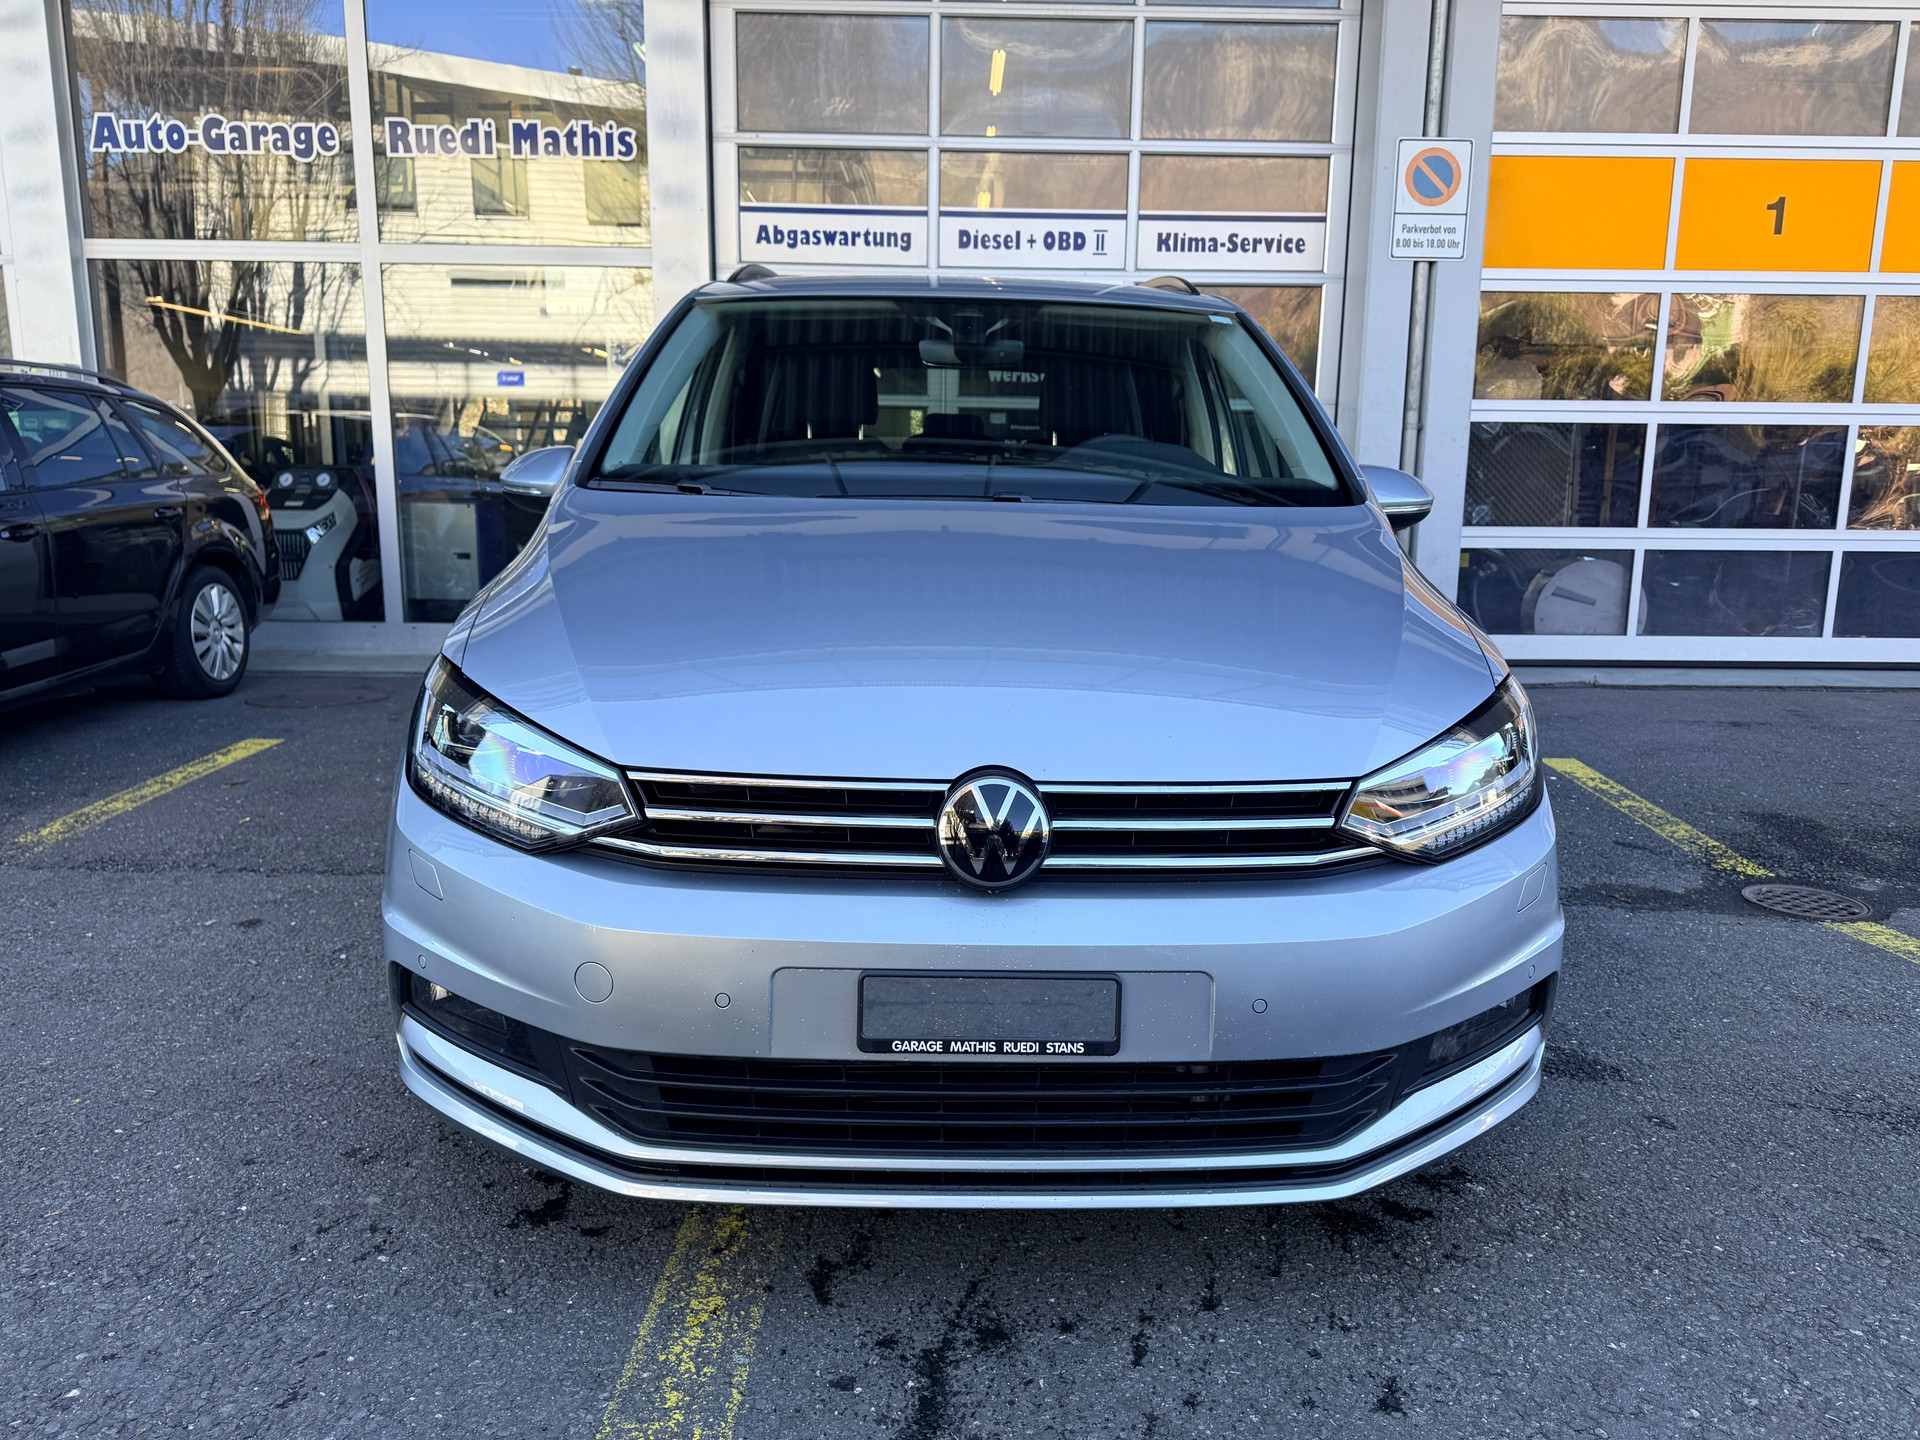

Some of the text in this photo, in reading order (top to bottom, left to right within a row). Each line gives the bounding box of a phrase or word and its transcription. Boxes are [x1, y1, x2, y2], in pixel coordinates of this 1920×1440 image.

[91, 113, 636, 161] Auto-Garage Ruedi Mathis
[1766, 196, 1786, 235] 1
[756, 225, 912, 252] Abgaswartung
[1402, 224, 1456, 234] Parkverbot von
[958, 229, 1021, 250] Diesel
[1043, 230, 1087, 251] OBD
[1156, 232, 1306, 253] Klima-Service
[1395, 238, 1460, 249] 8.00 bis 18.00 Uhr
[891, 1040, 1085, 1054] GARAGE MATHIS RUEDI STANS
